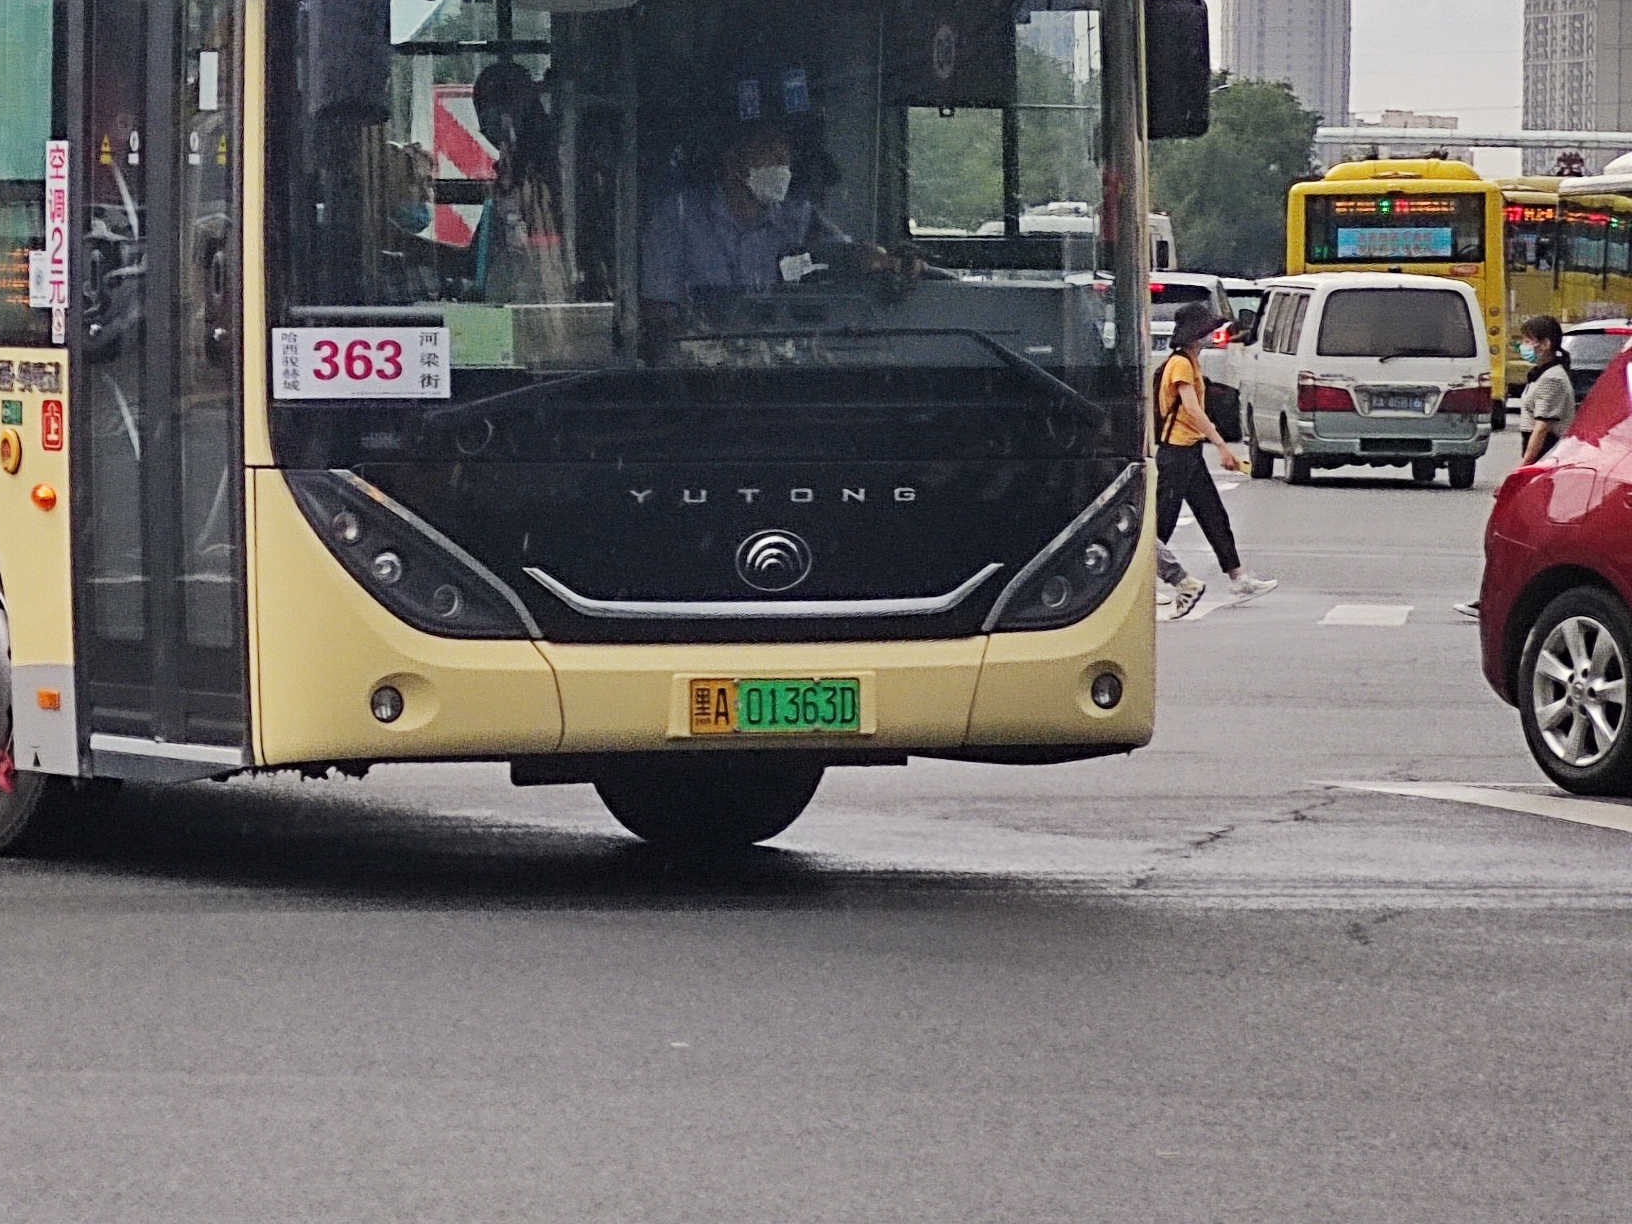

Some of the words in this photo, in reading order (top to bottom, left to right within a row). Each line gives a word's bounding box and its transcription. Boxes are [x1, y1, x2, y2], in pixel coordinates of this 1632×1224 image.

[49, 144, 66, 305] 空调2元
[312, 339, 403, 381] 363
[419, 331, 441, 389] 河梁街
[629, 487, 917, 504] YUTONG
[694, 687, 730, 726] 黑A
